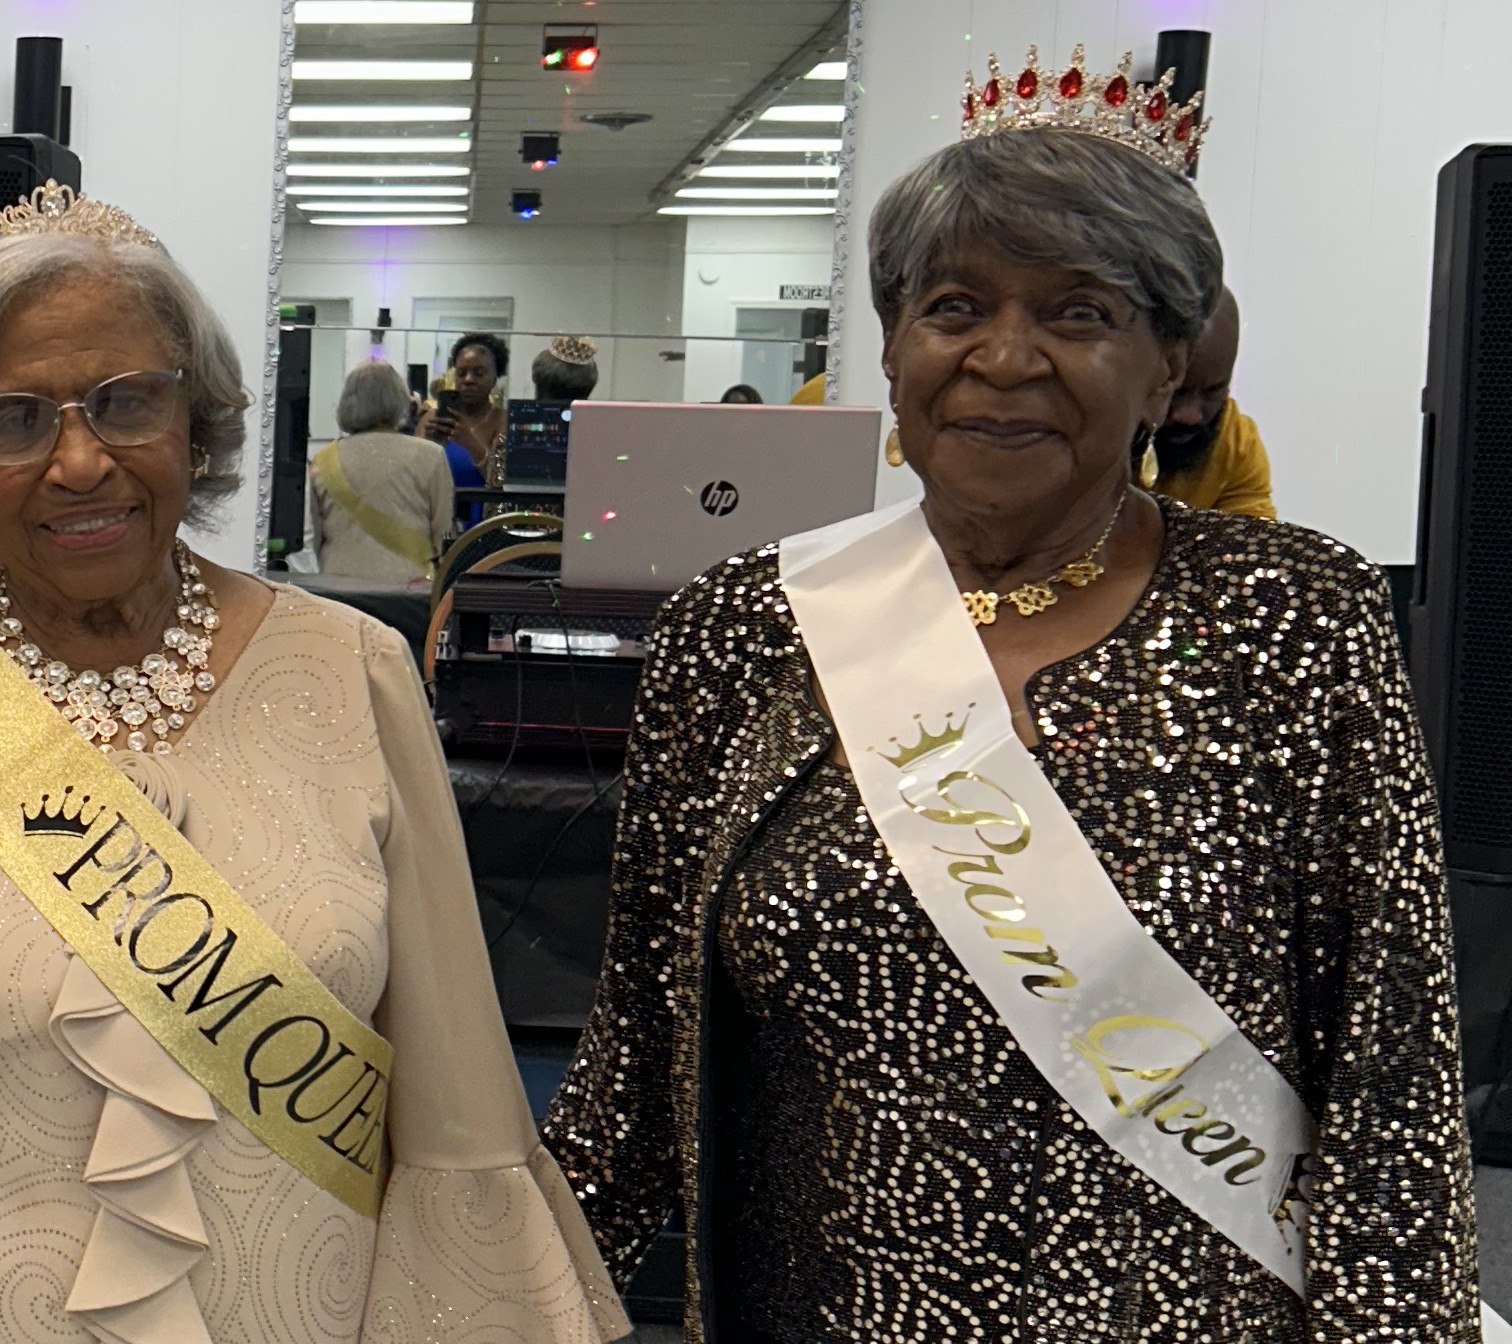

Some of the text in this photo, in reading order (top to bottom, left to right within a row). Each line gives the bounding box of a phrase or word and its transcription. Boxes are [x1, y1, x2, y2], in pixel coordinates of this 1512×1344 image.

[701, 480, 739, 517] hp
[52, 812, 387, 1175] PROM QUEE
[897, 771, 1079, 1003] Prom
